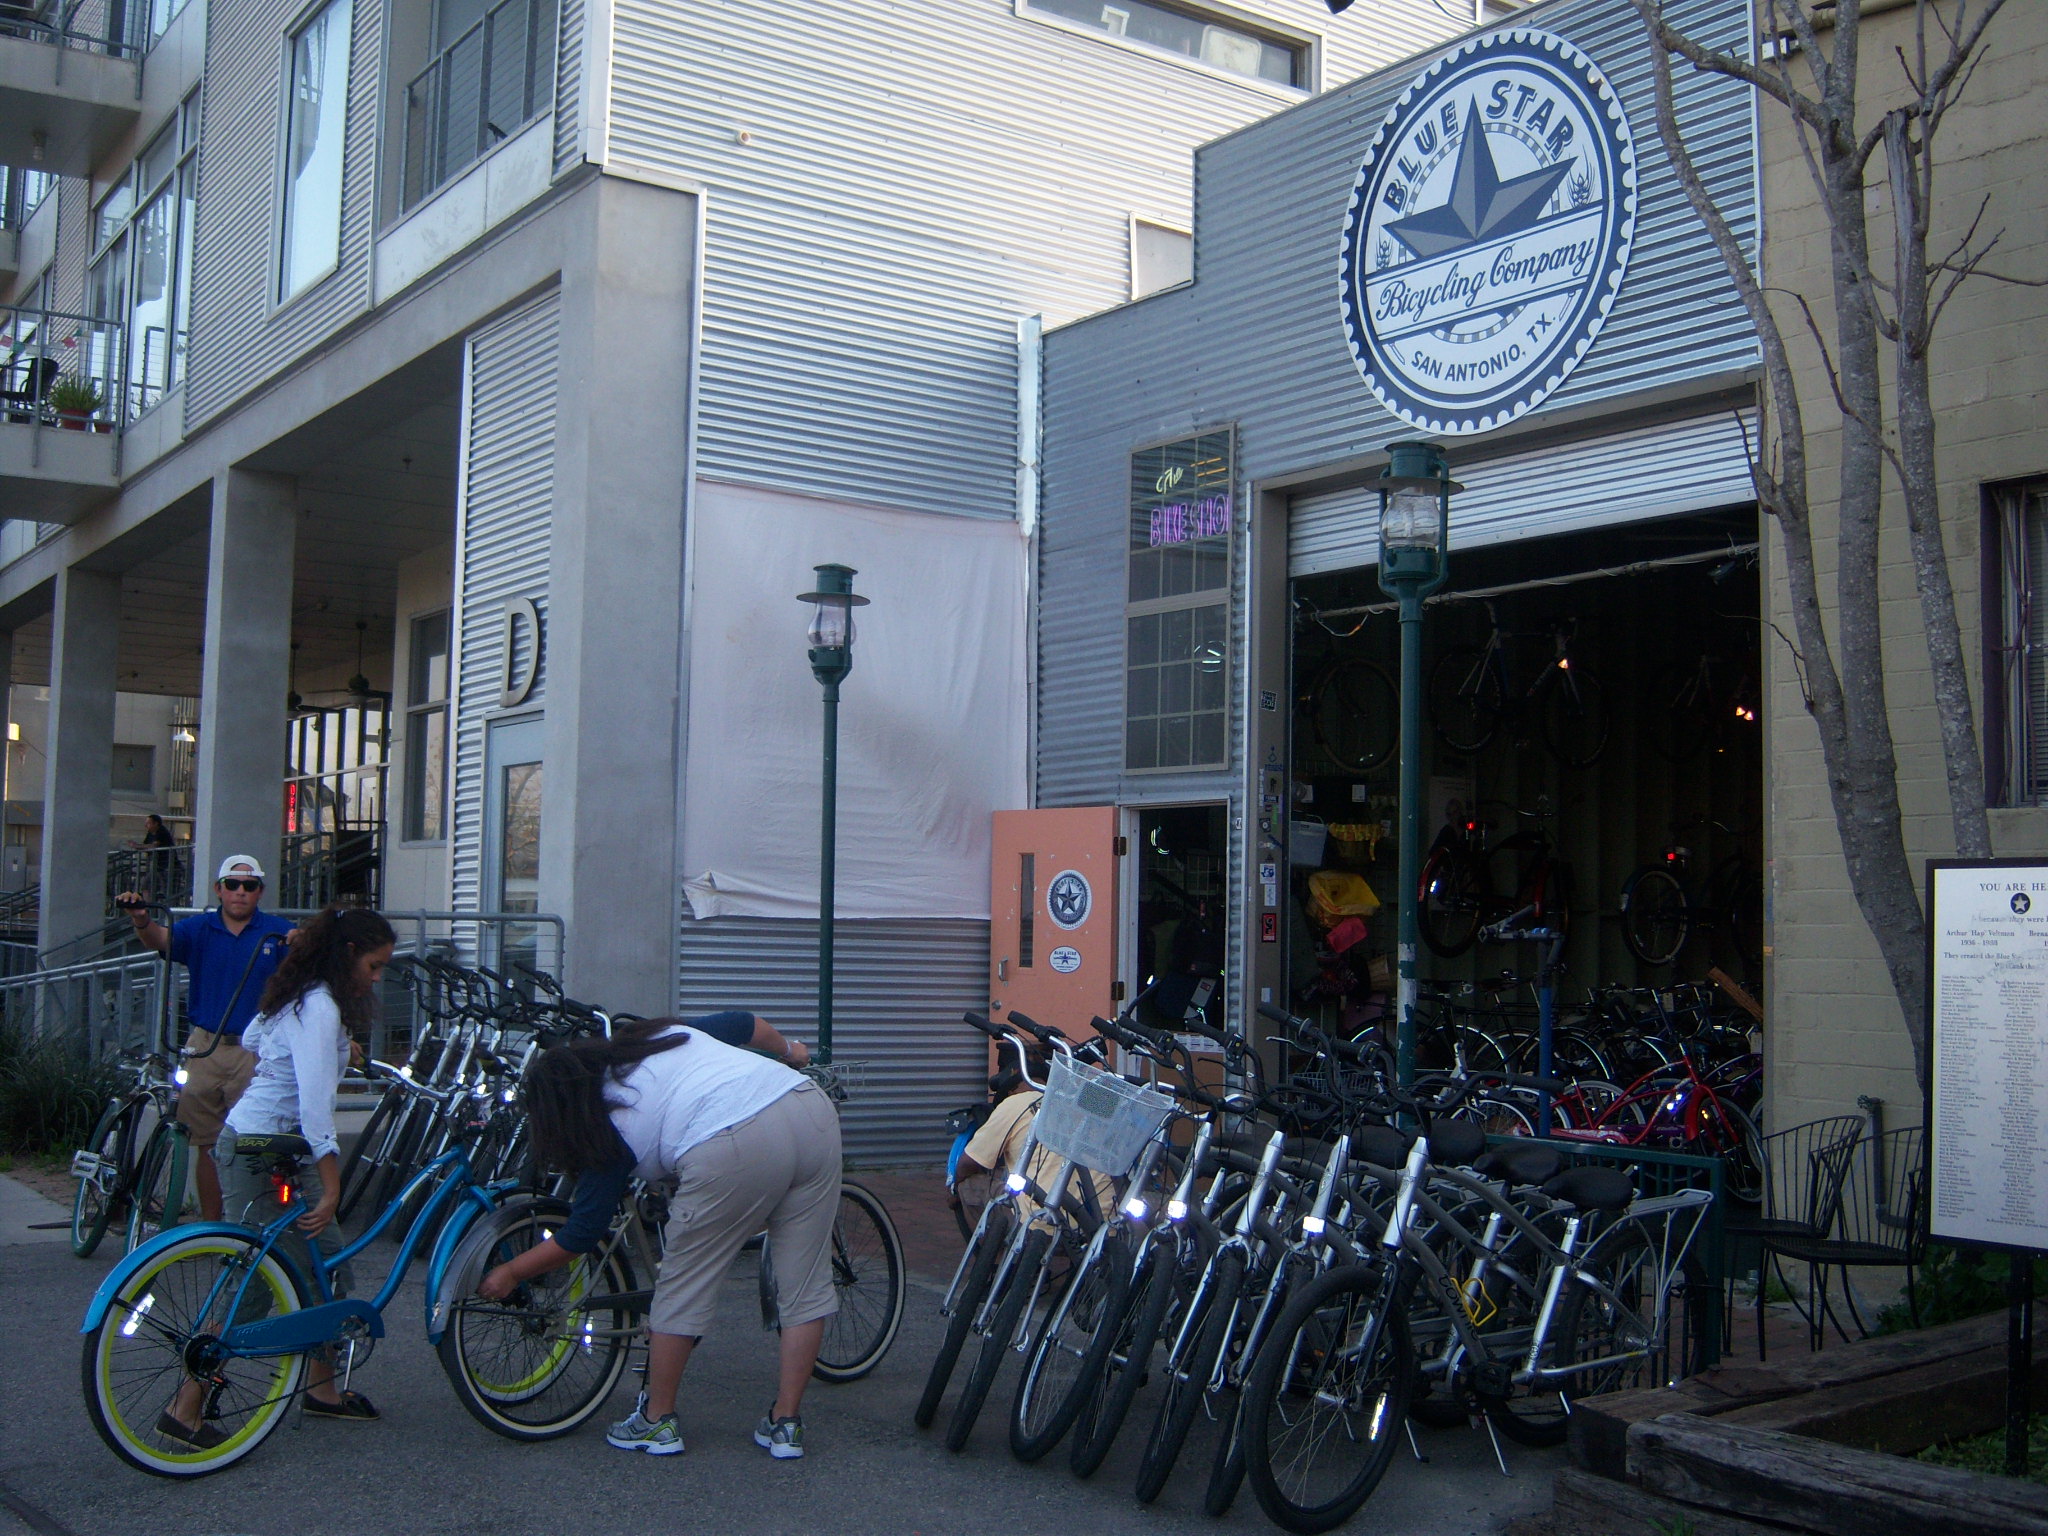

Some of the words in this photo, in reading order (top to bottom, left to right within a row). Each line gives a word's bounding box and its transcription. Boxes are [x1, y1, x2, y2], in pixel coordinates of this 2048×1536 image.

[1383, 100, 1459, 214] BLUE
[1486, 79, 1574, 161] STAR
[1376, 262, 1486, 322] Bicycling
[1489, 238, 1595, 287] Company
[1411, 350, 1443, 379] SAN
[1445, 343, 1527, 382] ANTONIO,
[1525, 311, 1557, 344] TX.
[1149, 502, 1188, 548] BIKE
[499, 596, 540, 708] D
[1980, 883, 2000, 891] YOU
[2005, 883, 2027, 891] ARE
[1946, 929, 1968, 937] Arthur
